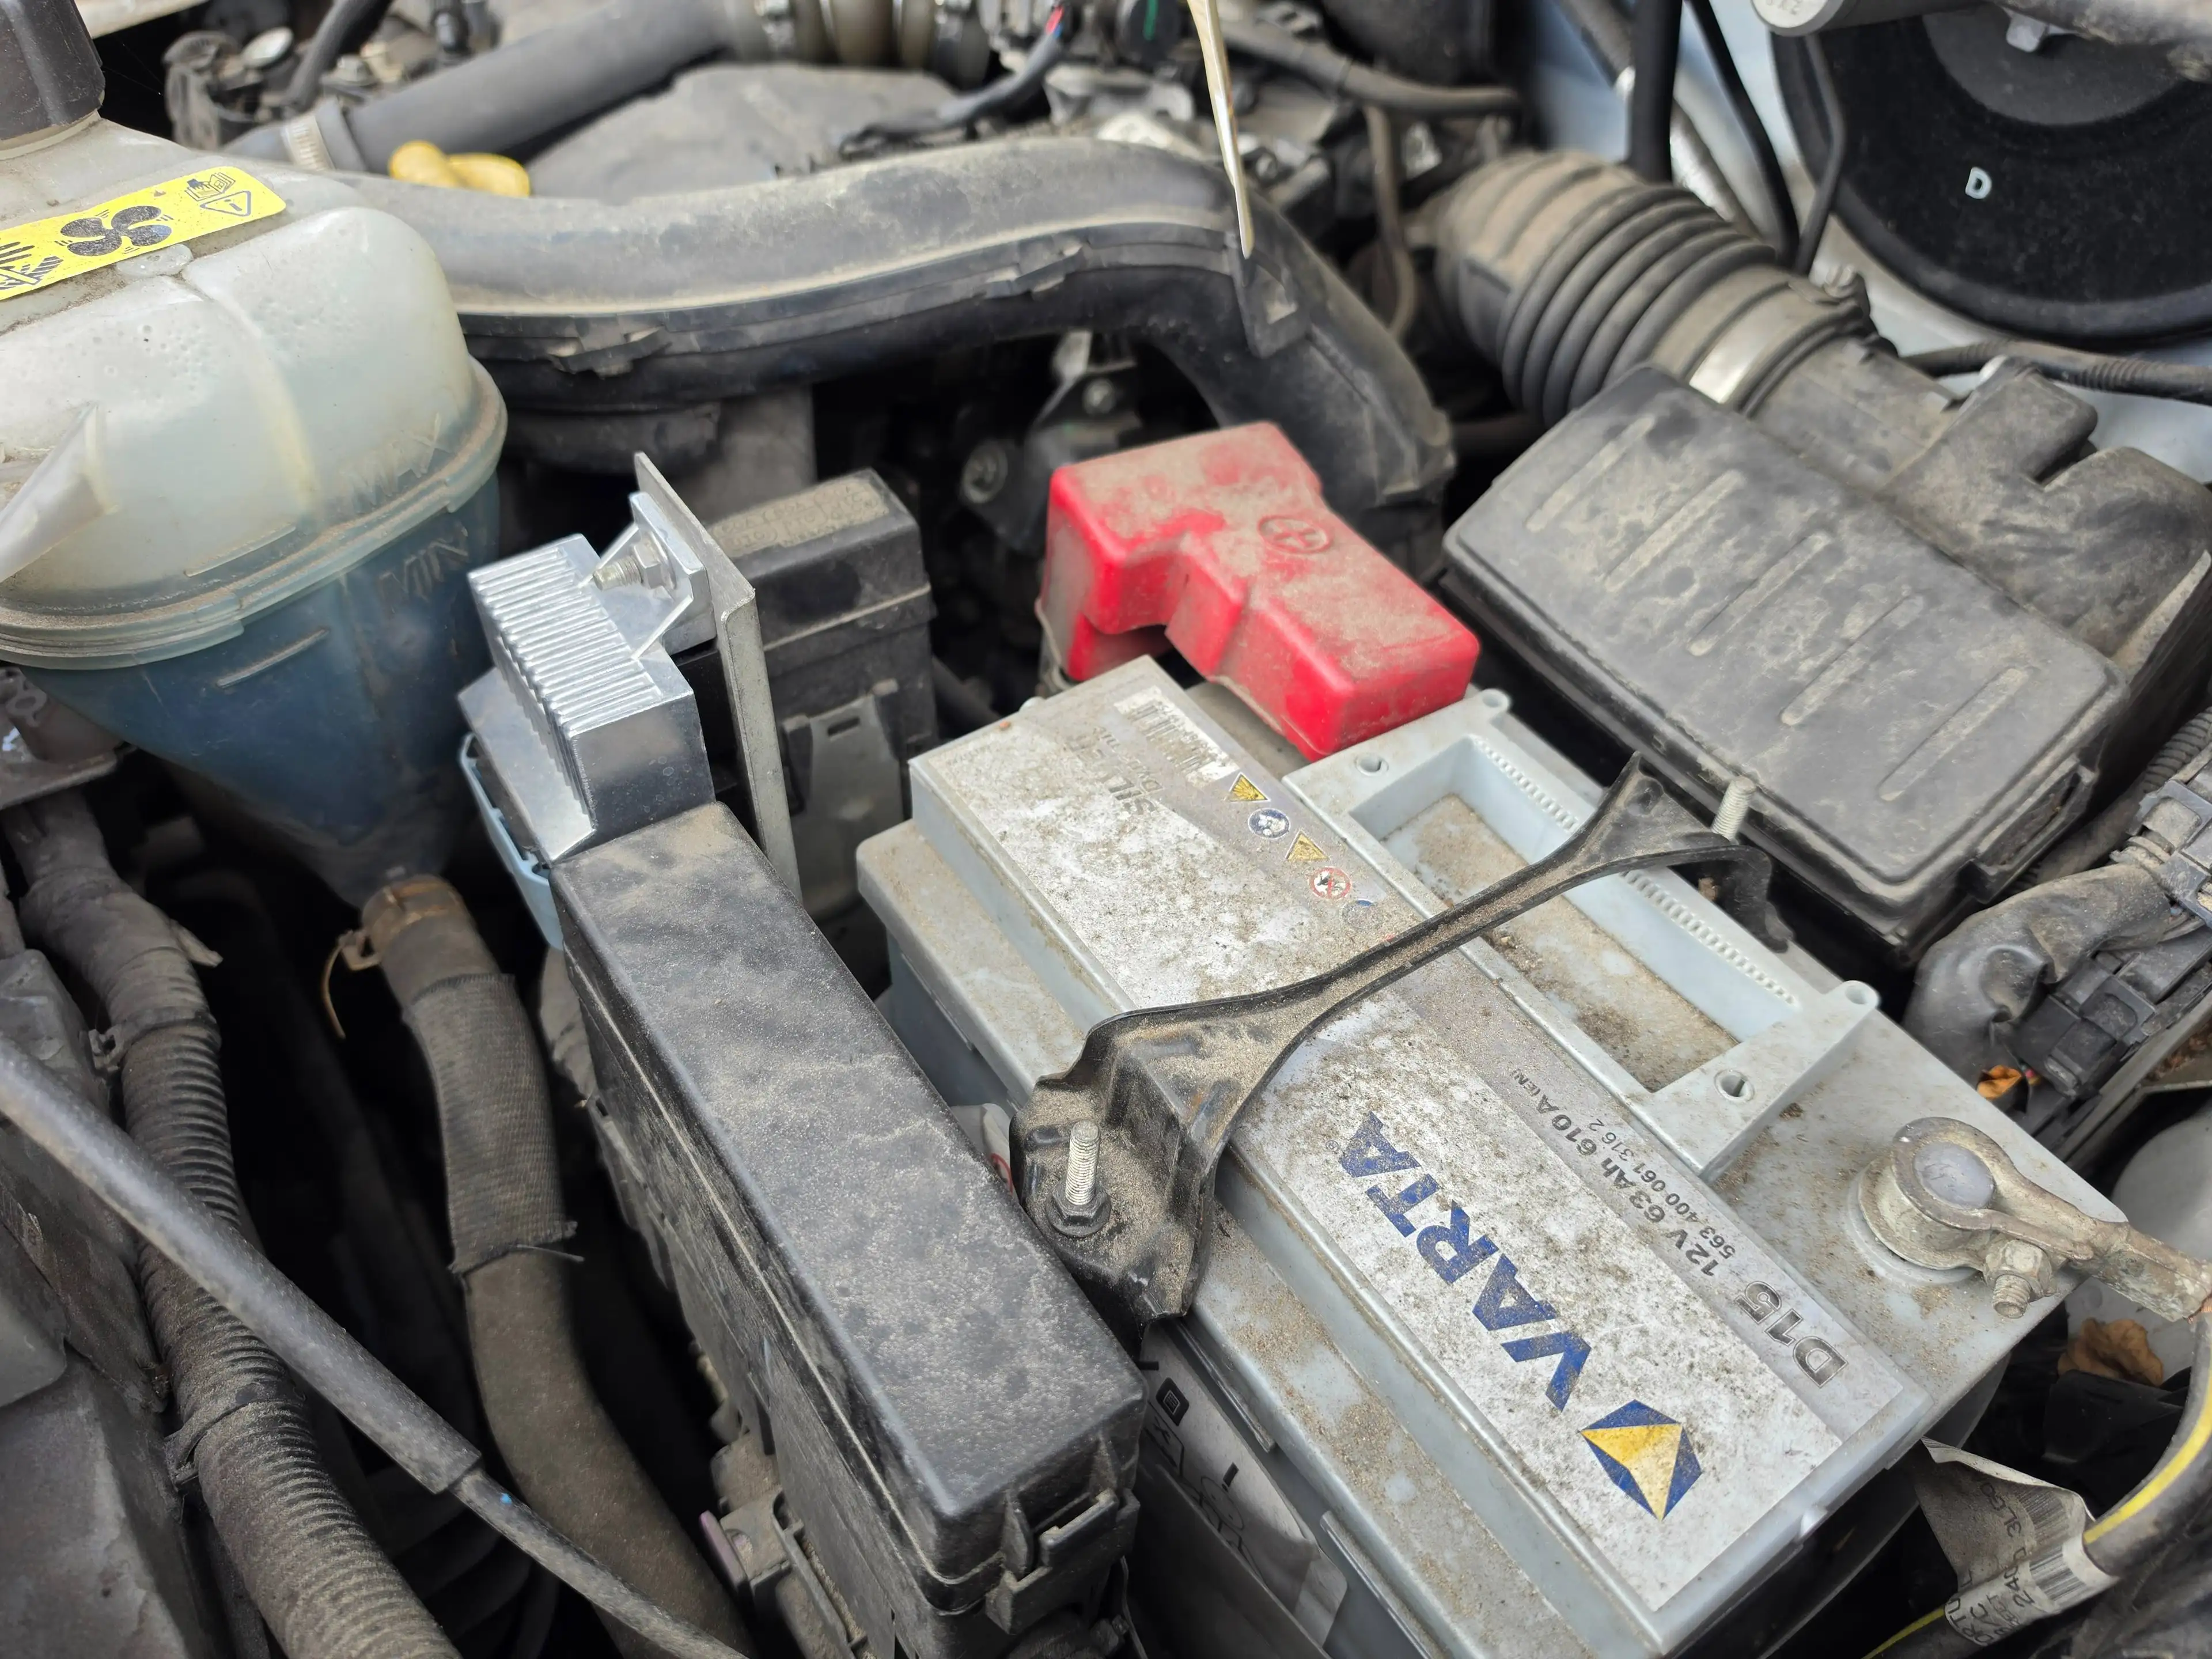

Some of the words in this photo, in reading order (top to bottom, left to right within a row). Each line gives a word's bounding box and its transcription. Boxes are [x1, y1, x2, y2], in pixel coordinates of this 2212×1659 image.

[1965, 166, 1993, 199] D
[1589, 1118, 1605, 1131] 2
[1601, 1132, 1635, 1161] 316
[1633, 1162, 1666, 1191] 061
[1666, 1193, 1704, 1222] 400
[1699, 1226, 1736, 1259] 563
[1341, 1111, 1592, 1412] VARTA
[1734, 1281, 1848, 1388] D15
